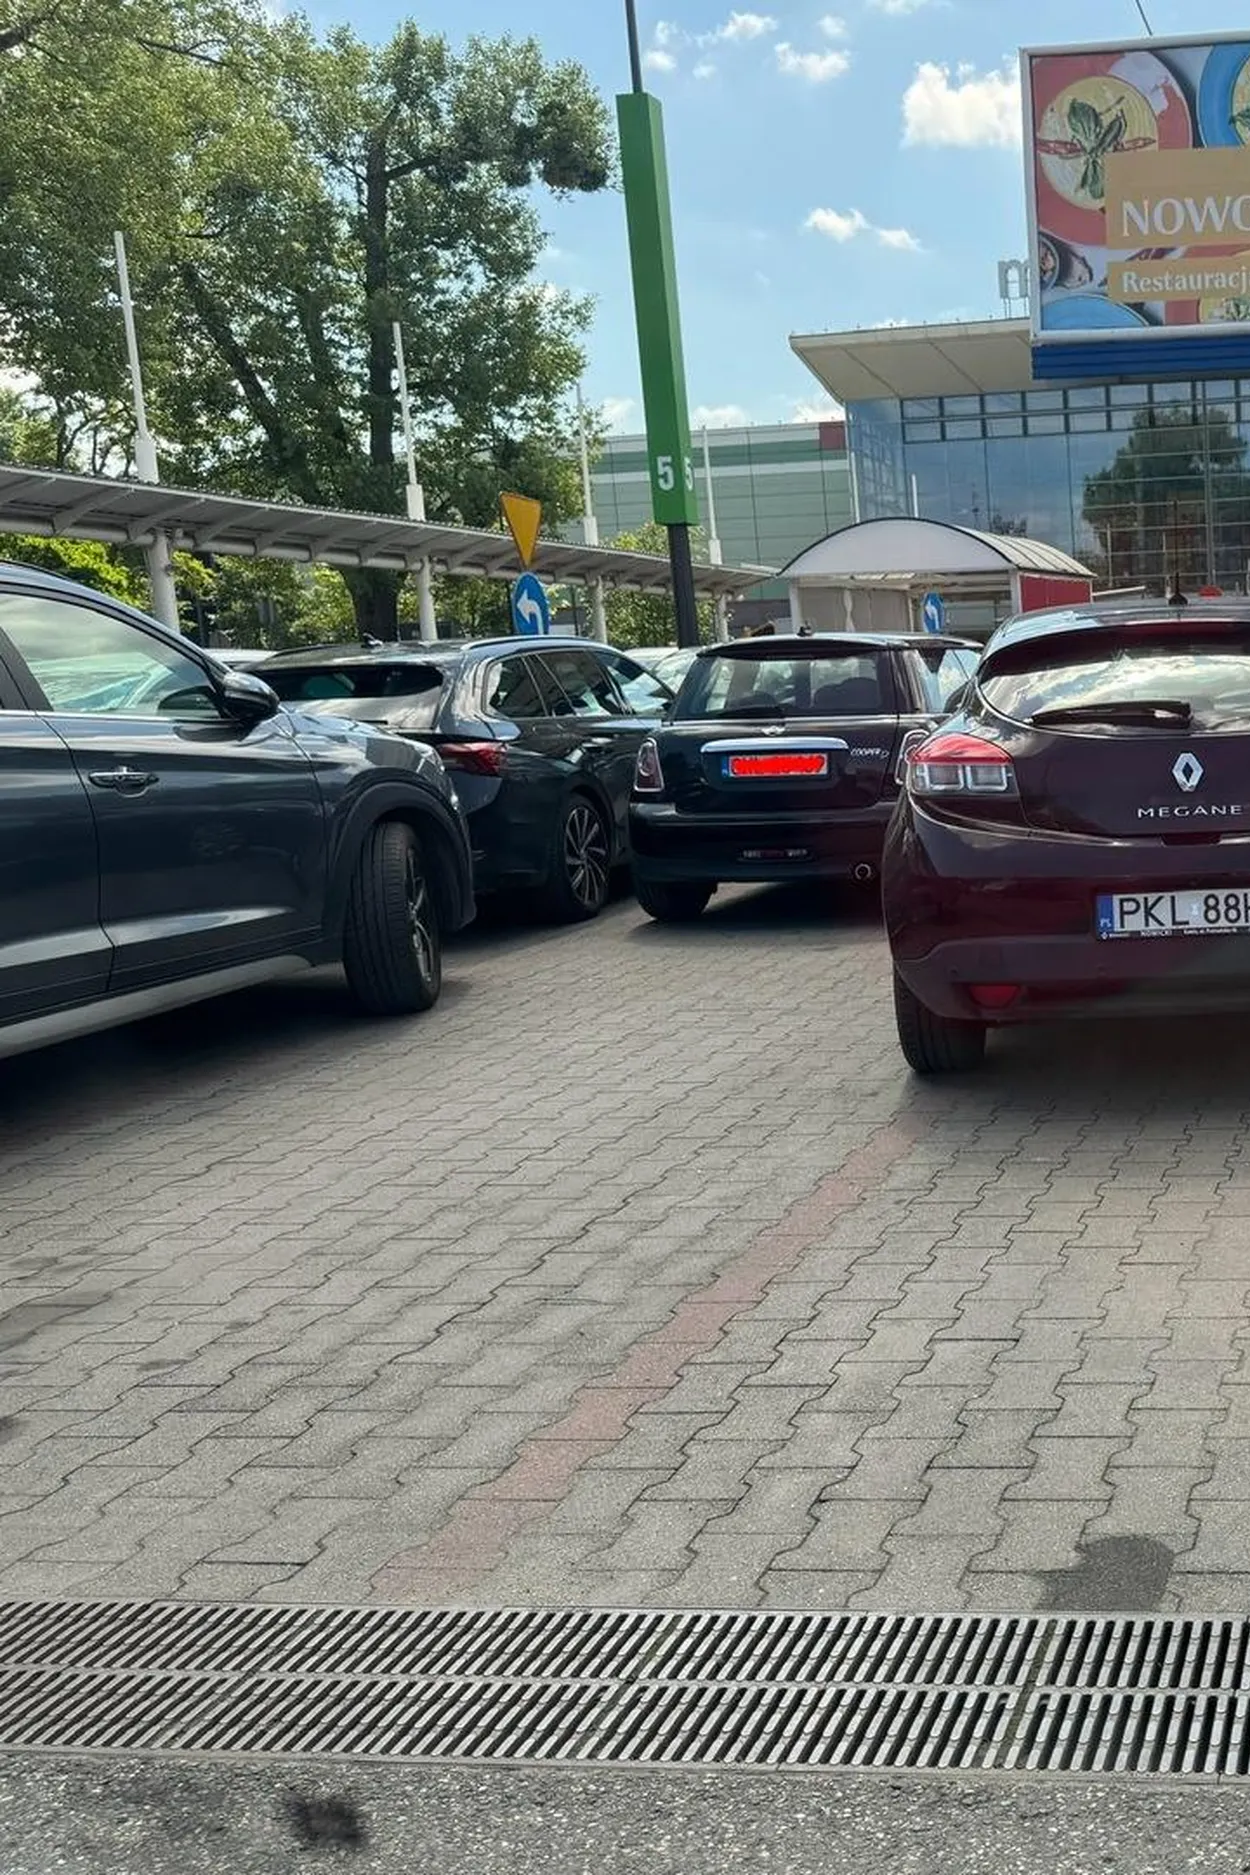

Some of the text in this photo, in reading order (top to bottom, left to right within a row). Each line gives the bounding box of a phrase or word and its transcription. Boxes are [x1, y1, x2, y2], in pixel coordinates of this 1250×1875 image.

[656, 456, 674, 490] 5
[1137, 804, 1242, 819] MEGANE
[1118, 895, 1190, 929] PKL
